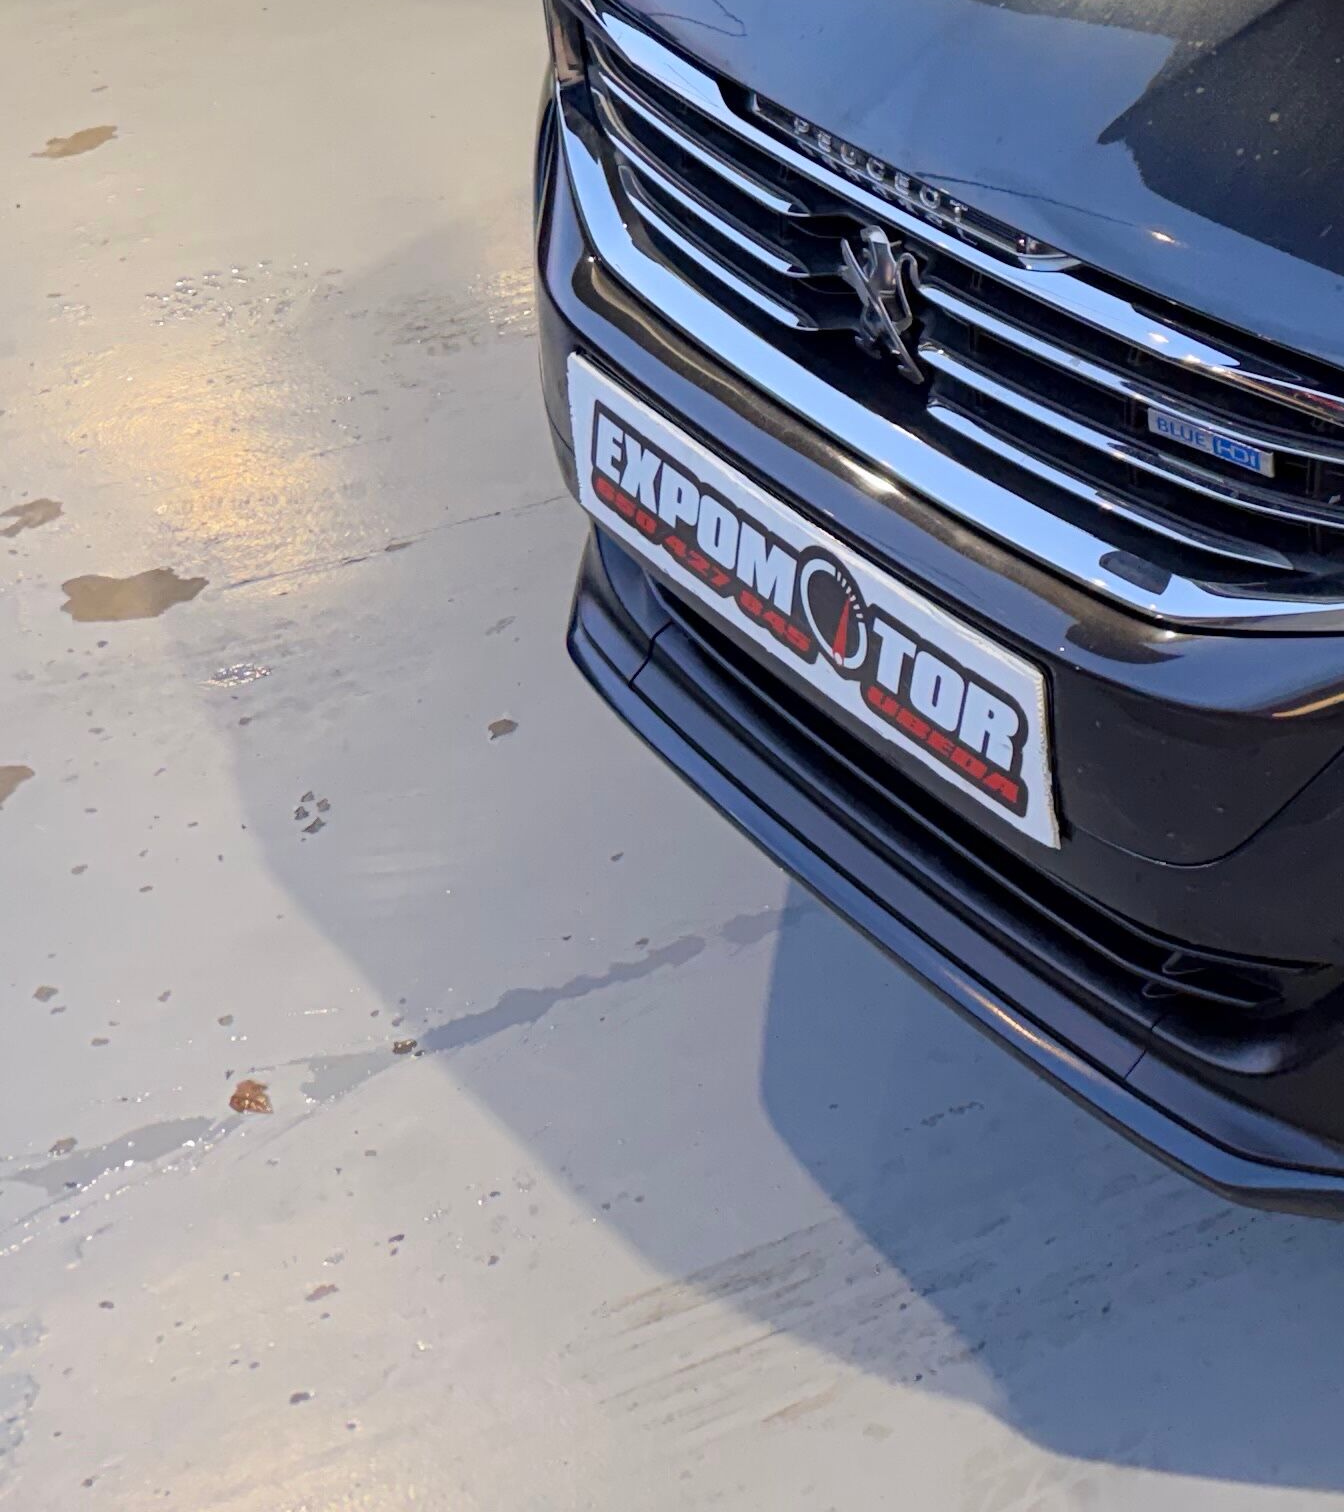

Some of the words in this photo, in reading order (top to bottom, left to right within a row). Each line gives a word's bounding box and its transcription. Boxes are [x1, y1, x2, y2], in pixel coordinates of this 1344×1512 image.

[793, 116, 968, 224] PEUGEOT
[1156, 416, 1207, 448] BLUE
[663, 534, 731, 588] 427
[867, 684, 1019, 804] UBEDA
